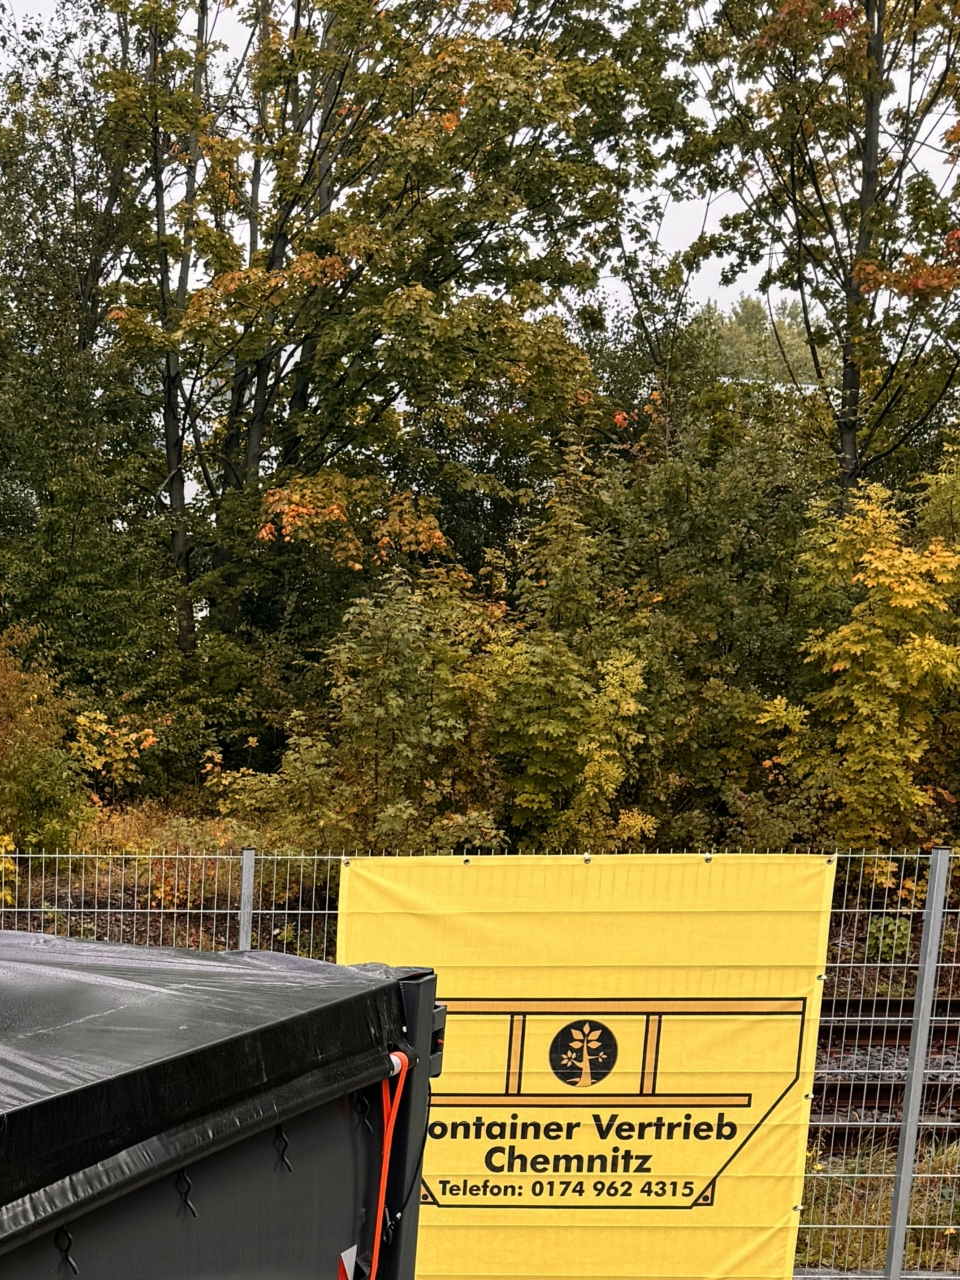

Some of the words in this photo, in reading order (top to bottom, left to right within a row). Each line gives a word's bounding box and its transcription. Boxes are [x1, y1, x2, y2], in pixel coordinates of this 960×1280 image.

[427, 1113, 581, 1140] ontainer
[592, 1113, 738, 1140] Vertrieb
[484, 1145, 653, 1174] Chemnitz
[439, 1179, 523, 1197] Telefon:
[531, 1181, 585, 1197] 0174
[593, 1181, 633, 1197] 962
[640, 1181, 695, 1197] 4315
